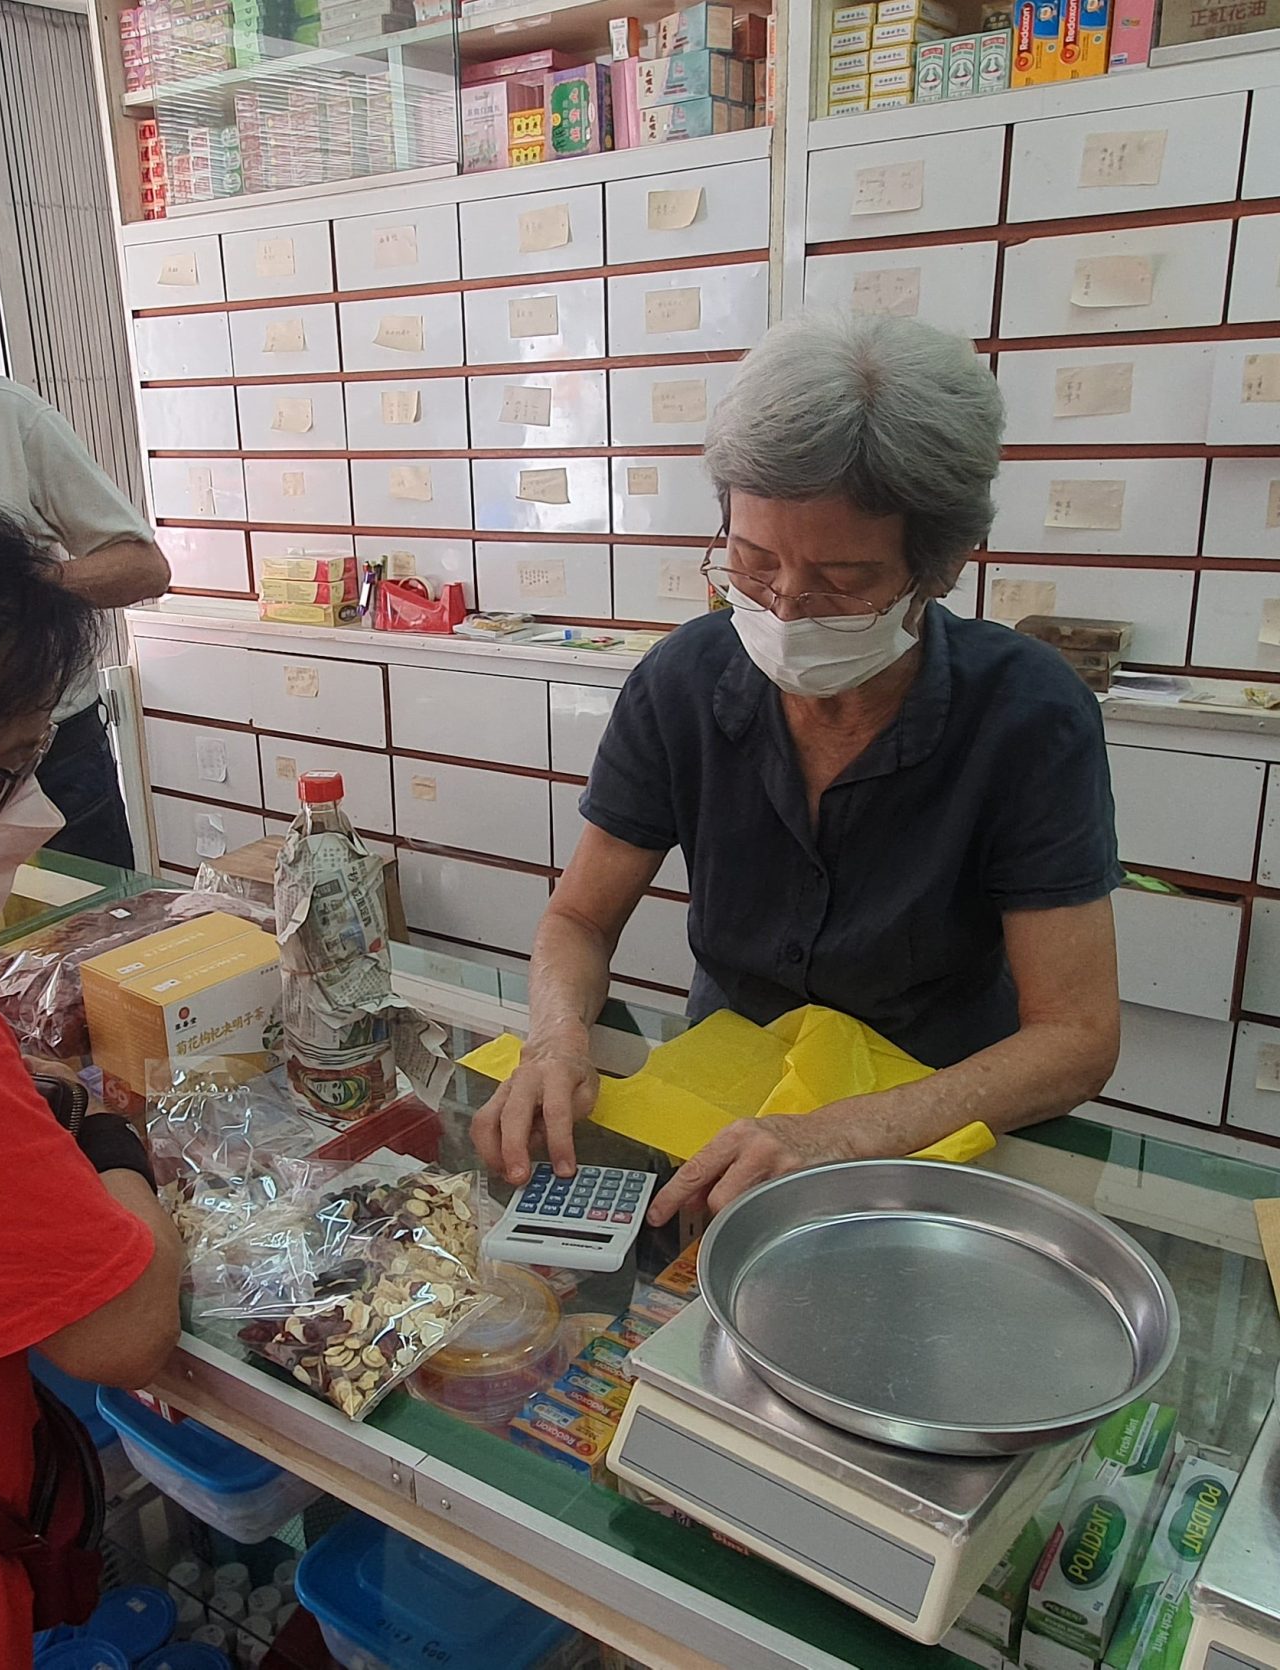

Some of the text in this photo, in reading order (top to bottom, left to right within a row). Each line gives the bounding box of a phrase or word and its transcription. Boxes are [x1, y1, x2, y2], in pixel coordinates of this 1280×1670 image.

[1019, 6, 1031, 50] Redoxon
[571, 1391, 610, 1416] Redoxon
[534, 1418, 577, 1447] Redoxon
[1182, 1482, 1222, 1554] POLIDENT
[1069, 1503, 1114, 1581] POLIDENT
